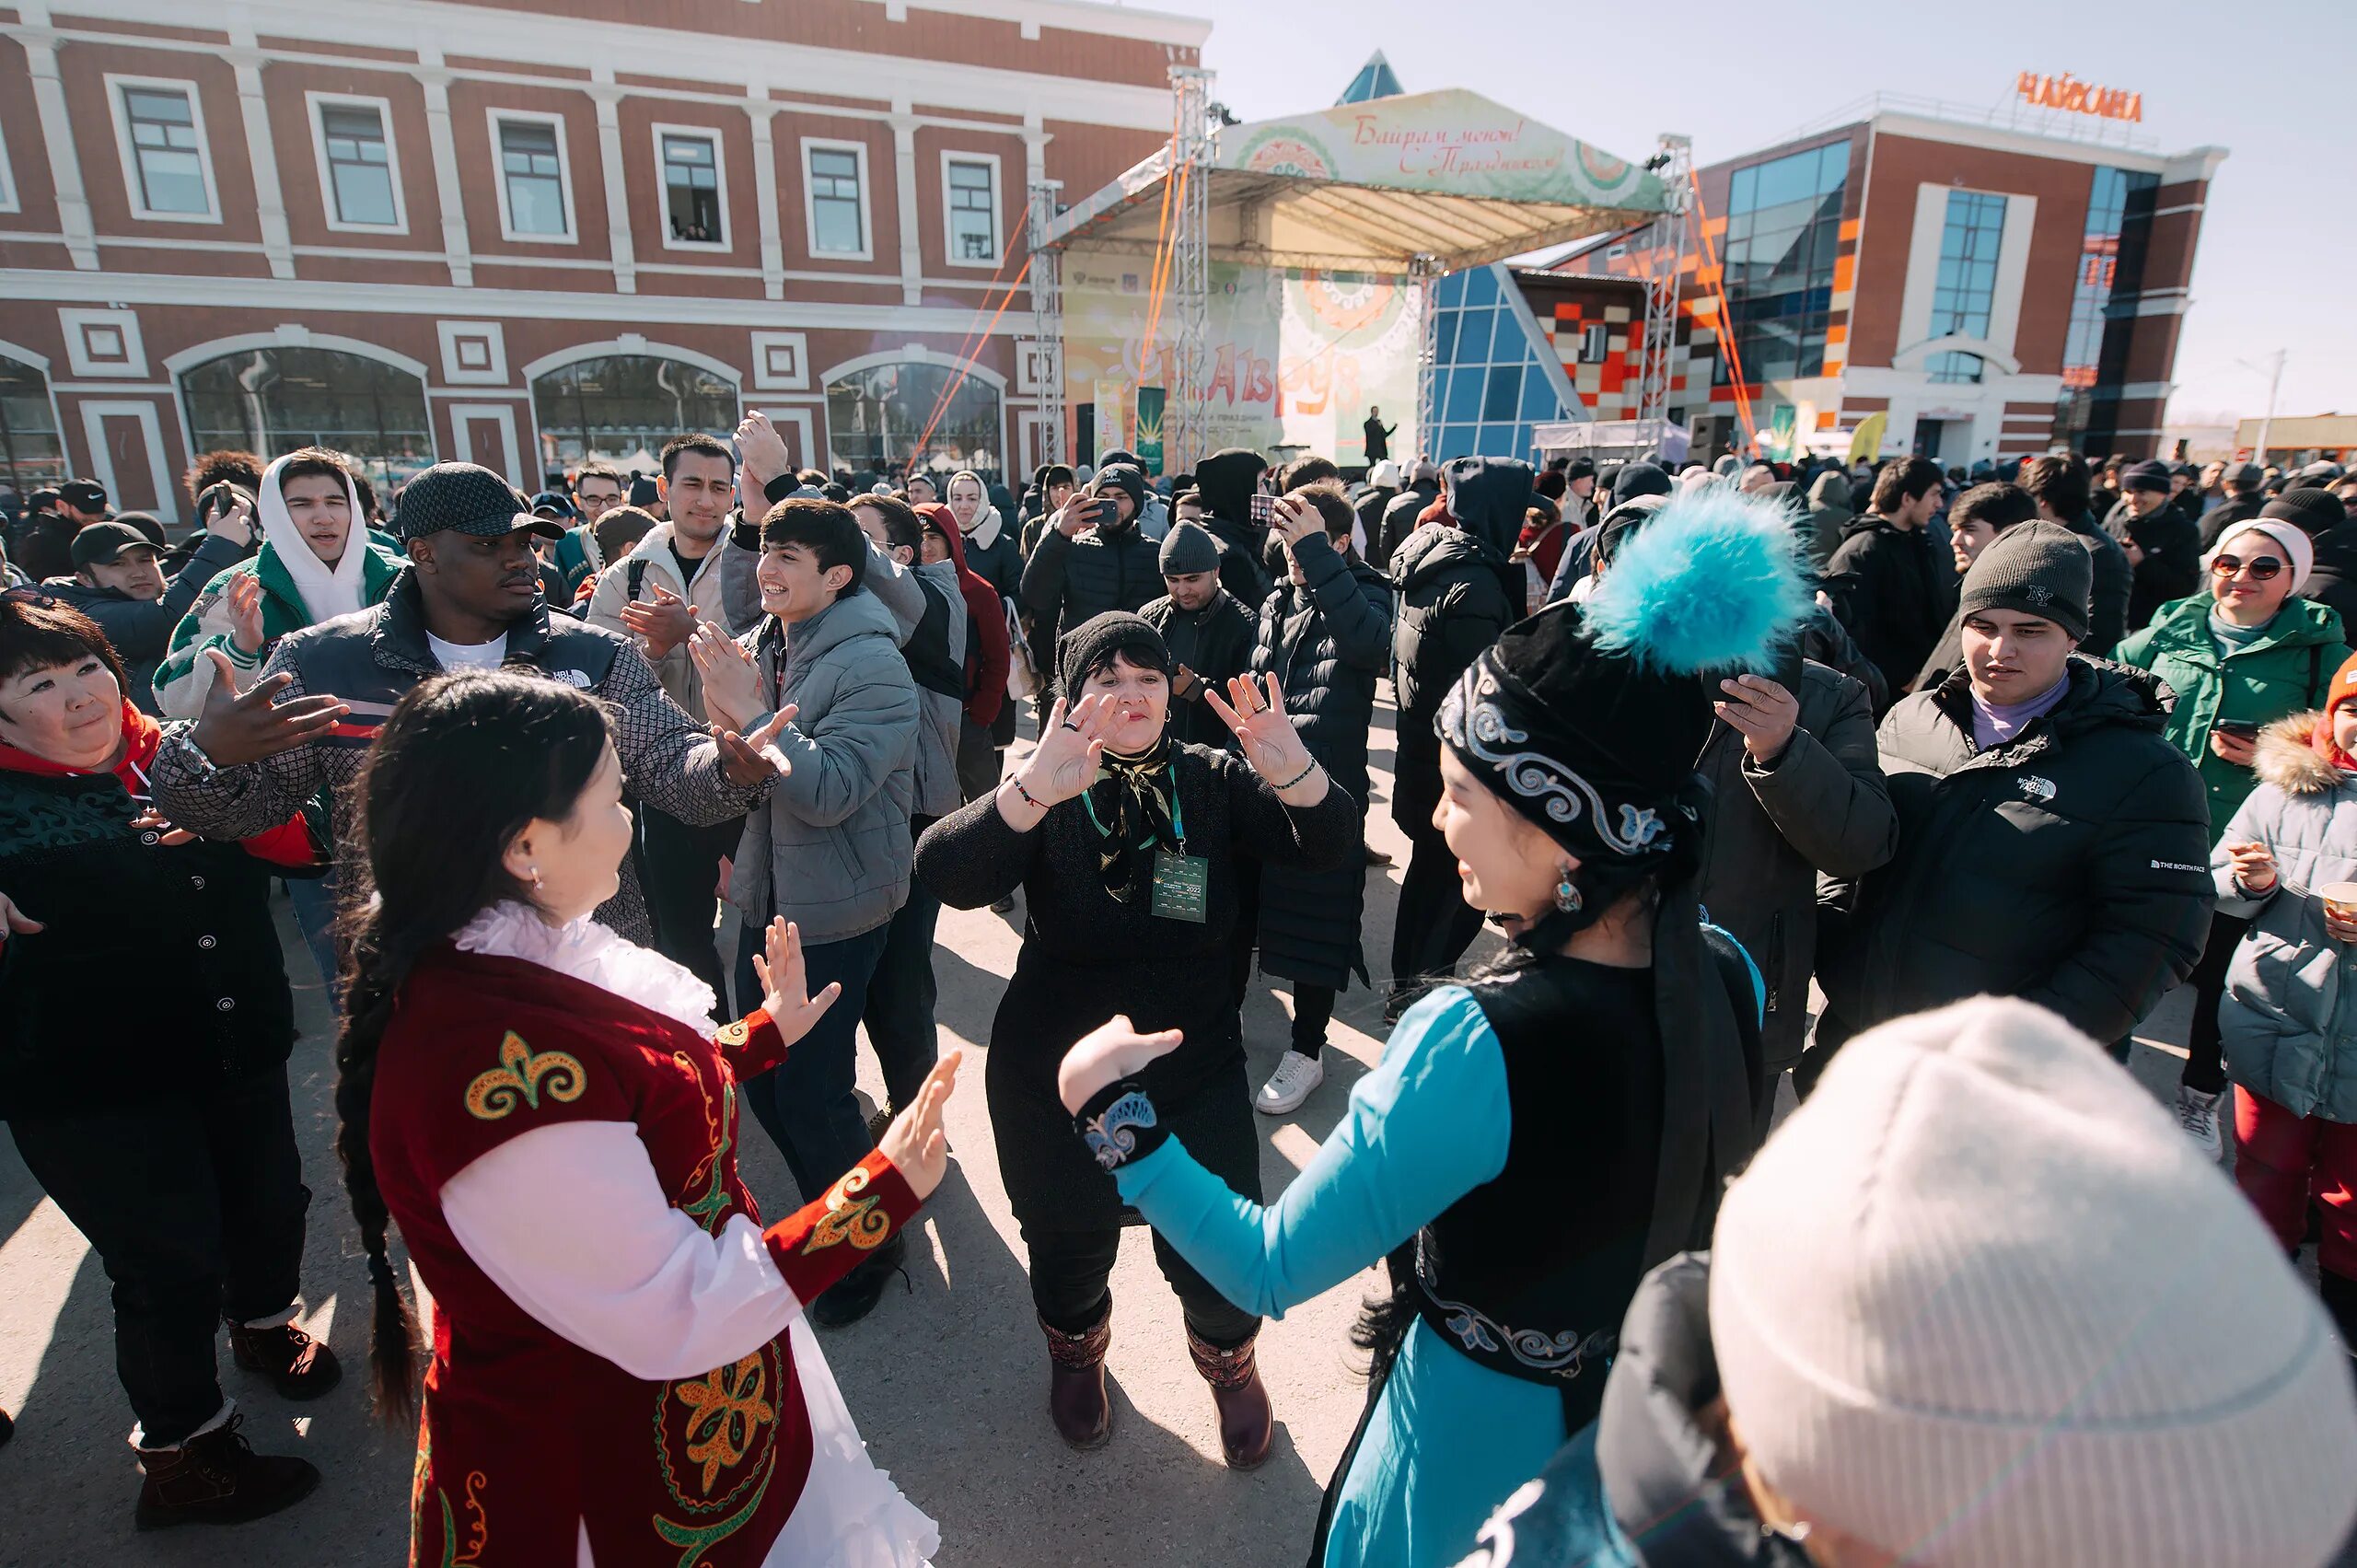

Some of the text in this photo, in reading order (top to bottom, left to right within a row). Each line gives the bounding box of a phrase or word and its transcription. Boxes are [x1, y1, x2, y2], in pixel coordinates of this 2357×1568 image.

[2017, 70, 2142, 122] ЧАЙХАНА
[2026, 585, 2053, 608] NY
[2017, 777, 2044, 790] NORTH
[2030, 774, 2046, 784] THE
[2019, 784, 2040, 795] FACE
